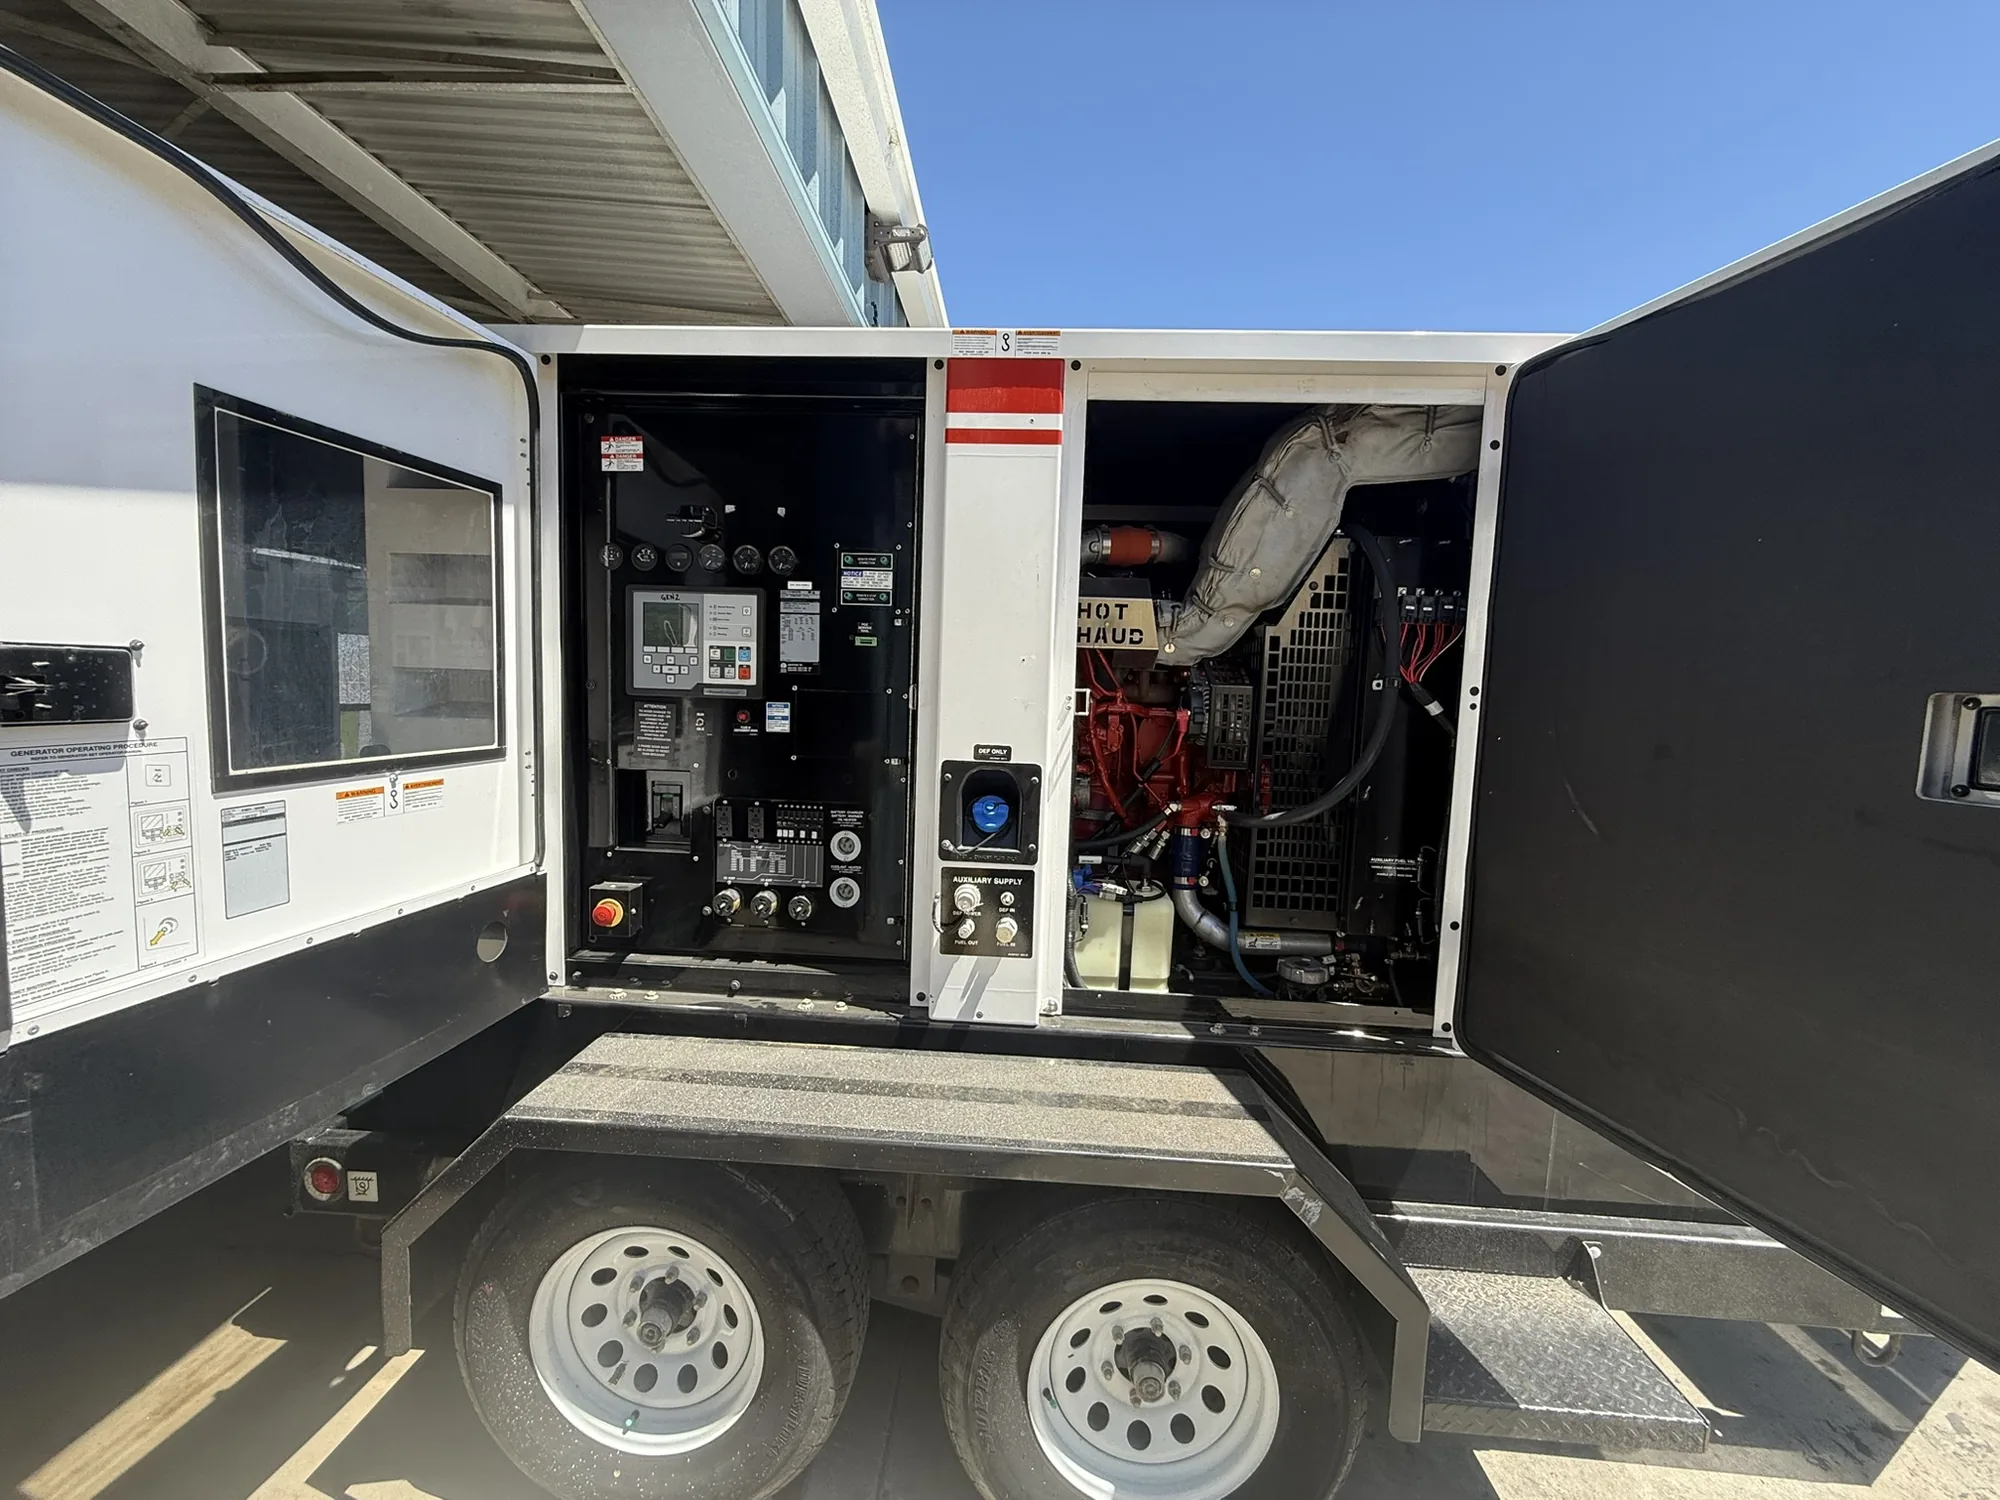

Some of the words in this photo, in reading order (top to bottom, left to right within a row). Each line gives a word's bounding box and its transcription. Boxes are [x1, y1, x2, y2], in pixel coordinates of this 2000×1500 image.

[1078, 603, 1128, 620] HOT
[10, 747, 64, 757] GENERATOR
[66, 744, 112, 754] OPERATING
[113, 741, 158, 750] PROCEDURE
[350, 788, 376, 796] WARNING
[953, 876, 992, 884] AUXILIARY
